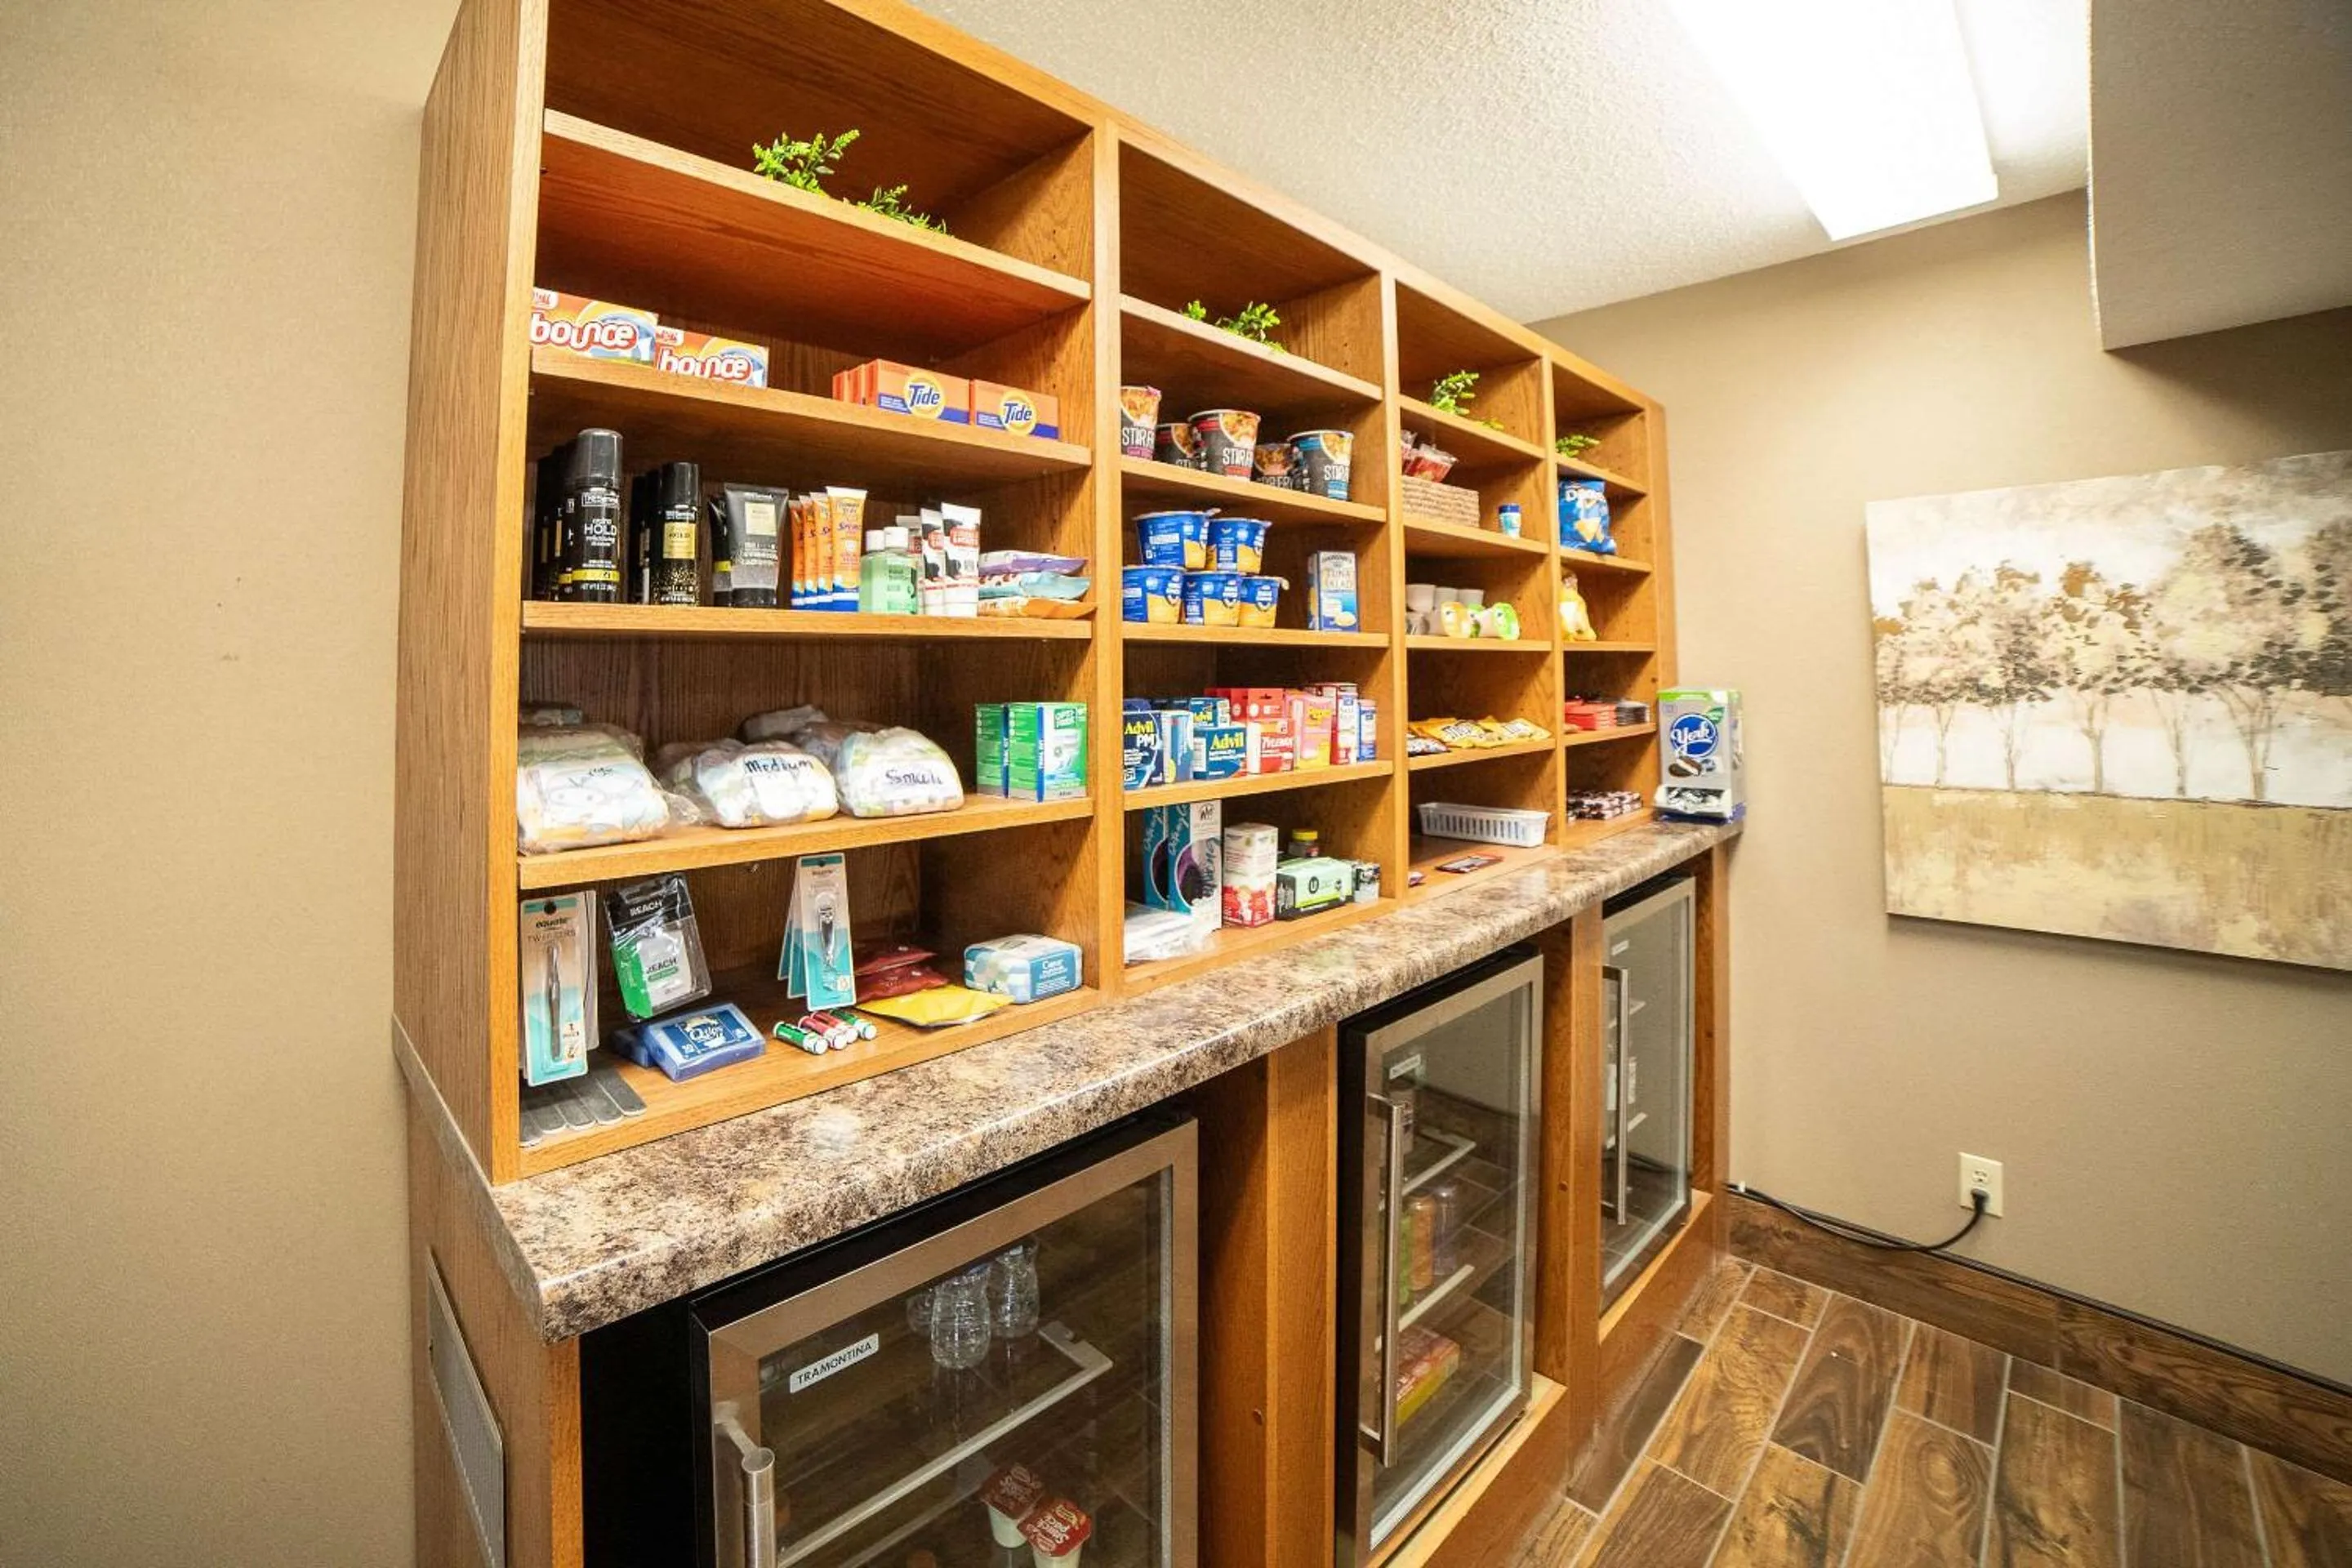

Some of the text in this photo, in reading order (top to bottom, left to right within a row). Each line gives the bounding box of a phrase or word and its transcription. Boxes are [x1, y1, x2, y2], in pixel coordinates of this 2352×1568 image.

[529, 310, 637, 350] bounce
[657, 348, 755, 381] bounce
[908, 385, 940, 407] Tide
[1004, 403, 1032, 424] Tide
[584, 523, 617, 536] HOLD
[1125, 720, 1154, 734] Advil
[1671, 720, 1713, 750] York
[1136, 733, 1156, 747] PM
[1210, 732, 1244, 750] Advil
[745, 759, 814, 773] Medium
[630, 899, 663, 916] REACH
[796, 1342, 872, 1384] TRAMONTINA
